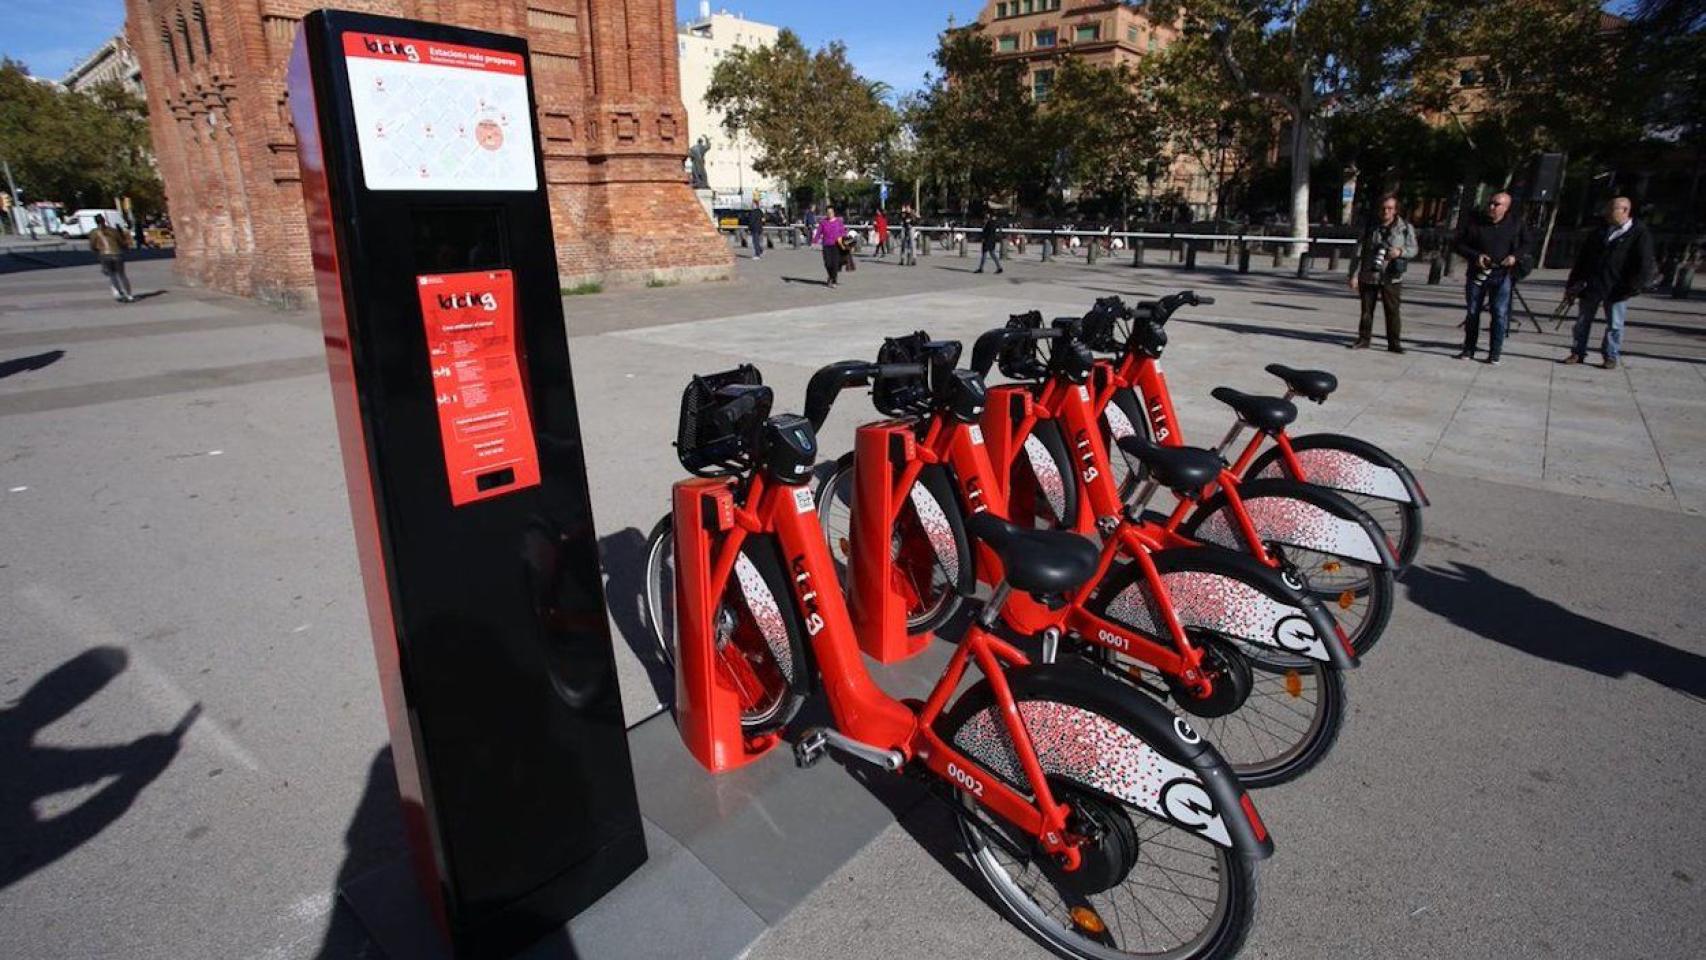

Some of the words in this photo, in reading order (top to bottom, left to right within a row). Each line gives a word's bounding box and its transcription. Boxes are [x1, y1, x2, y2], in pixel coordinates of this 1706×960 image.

[364, 37, 420, 63] bicing
[438, 291, 498, 311] bicing
[1098, 629, 1130, 651] 0001
[947, 762, 984, 798] 0002
